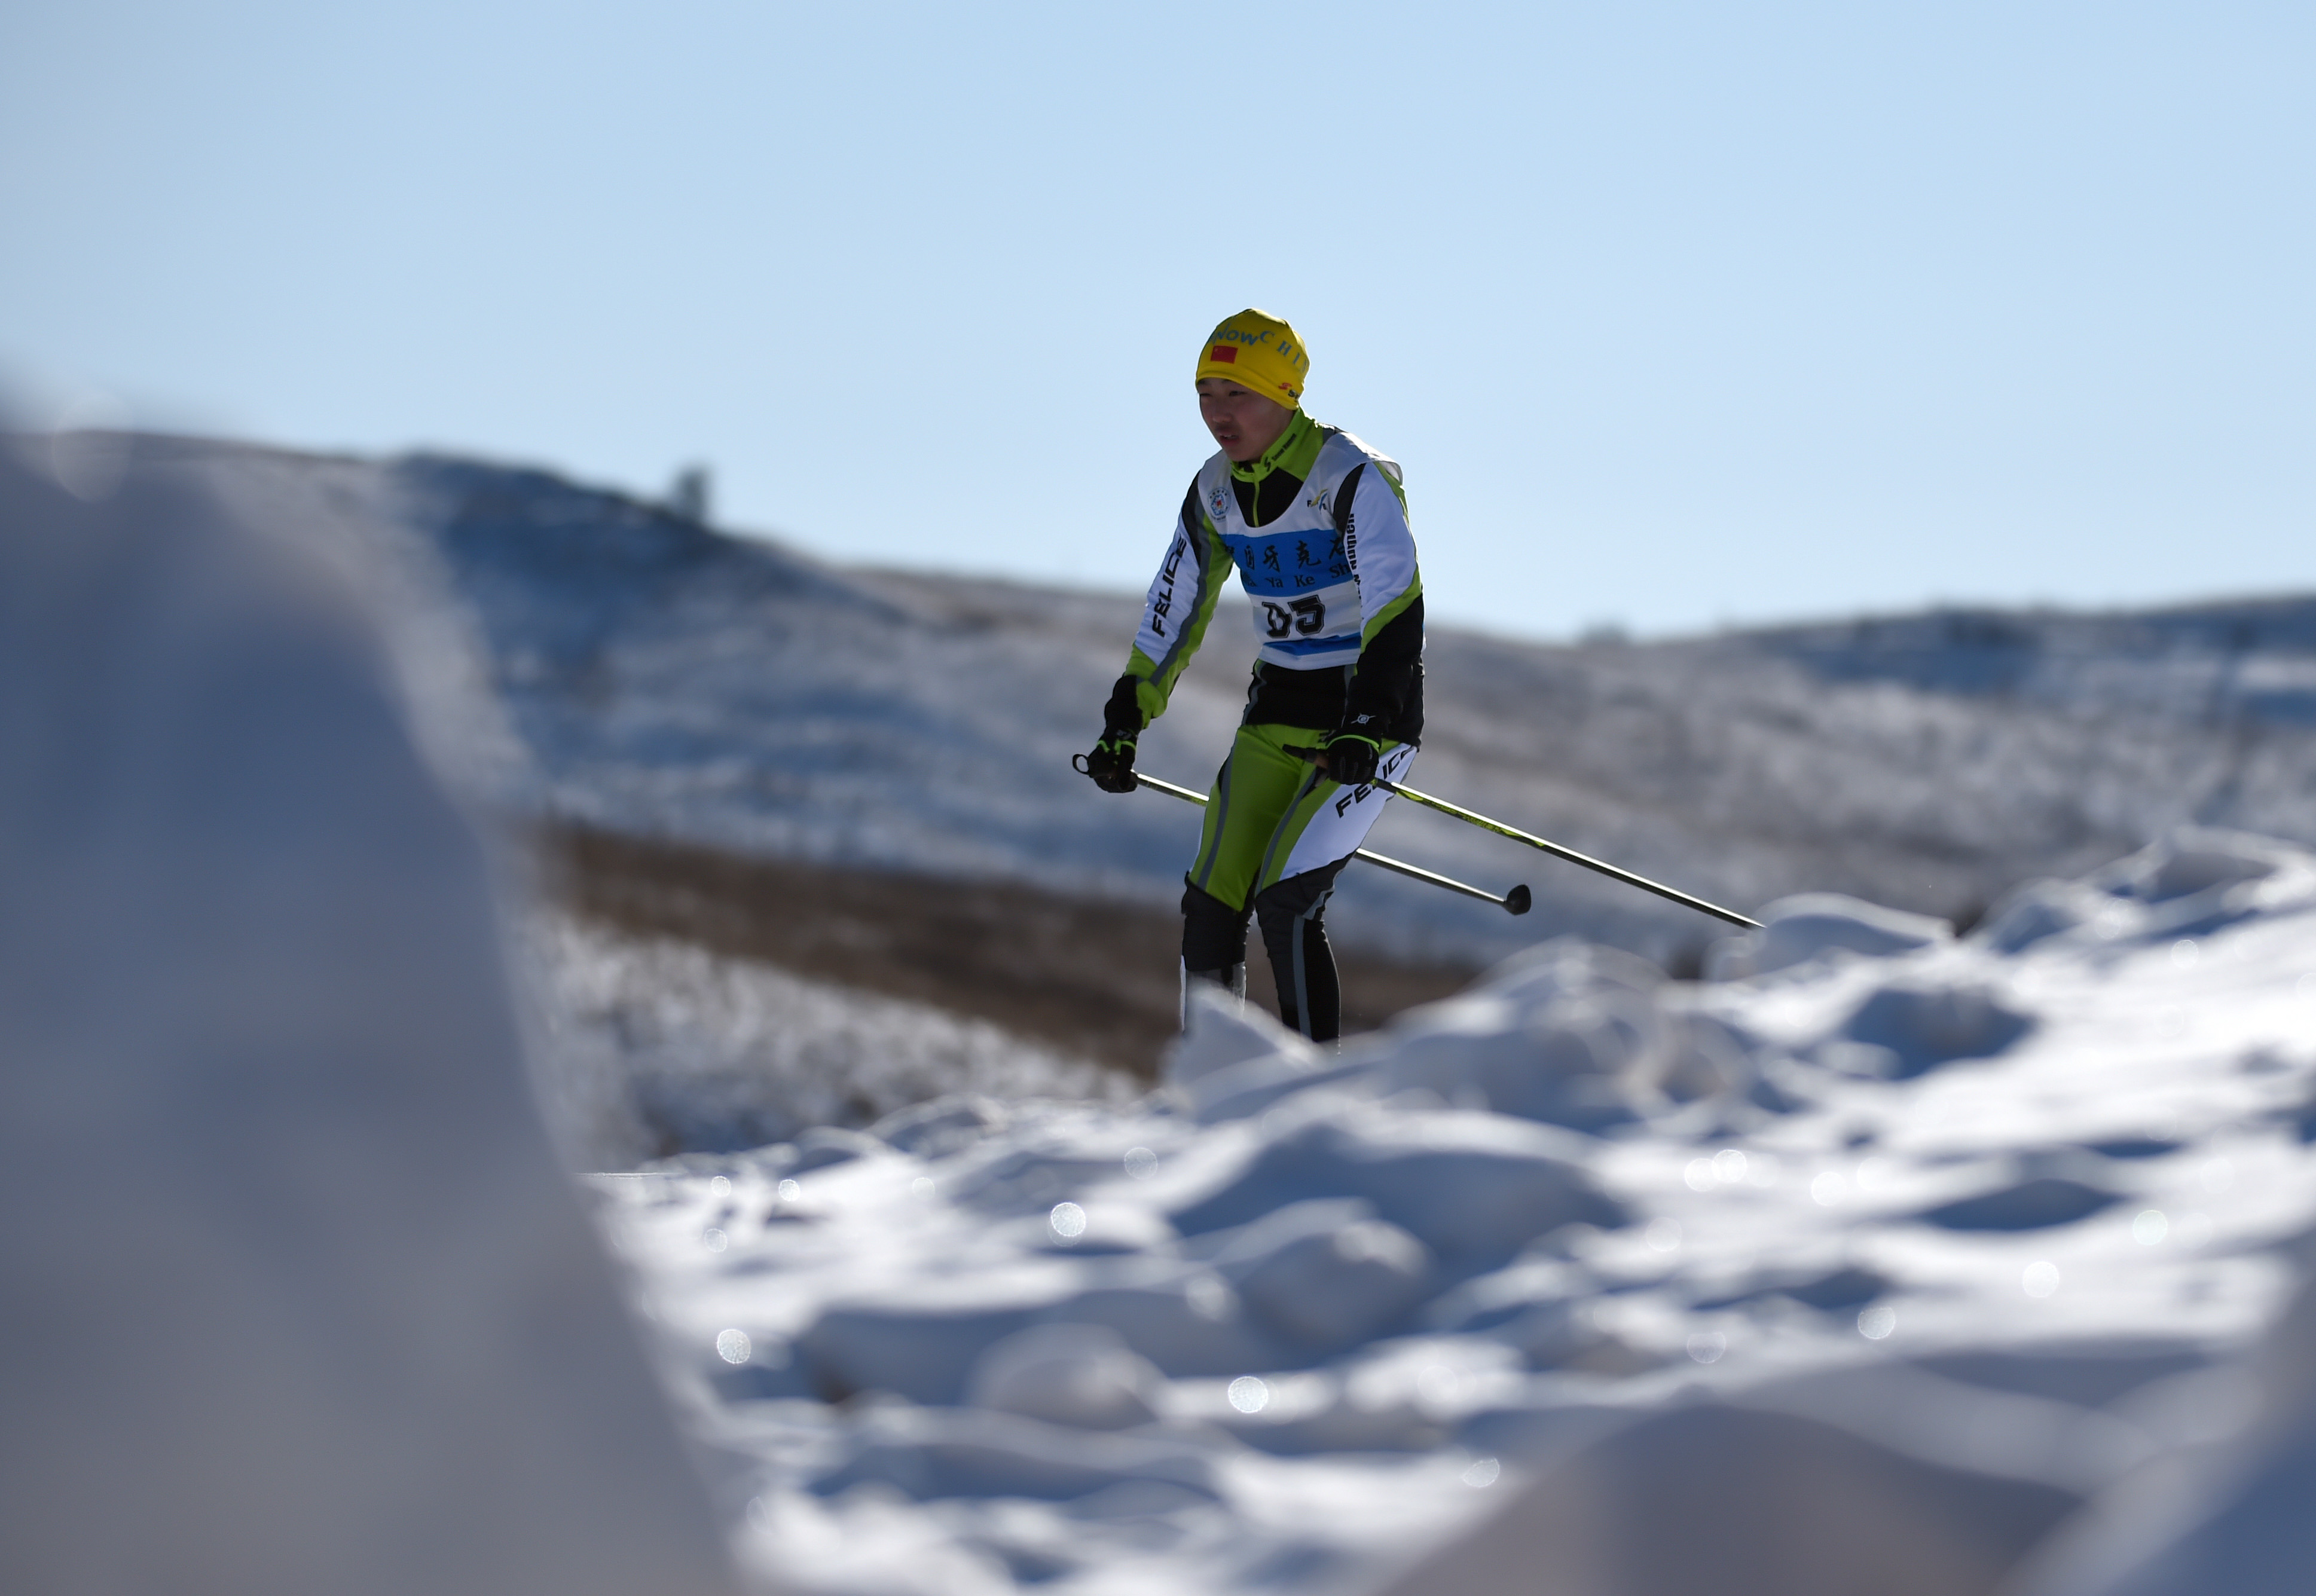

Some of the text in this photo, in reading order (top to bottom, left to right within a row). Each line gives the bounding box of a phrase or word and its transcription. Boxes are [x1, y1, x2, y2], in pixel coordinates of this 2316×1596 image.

[1152, 534, 1187, 638] FELICE
[1264, 577, 1284, 588] Ya
[1294, 574, 1316, 587] Ke
[1329, 563, 1351, 578] Sh
